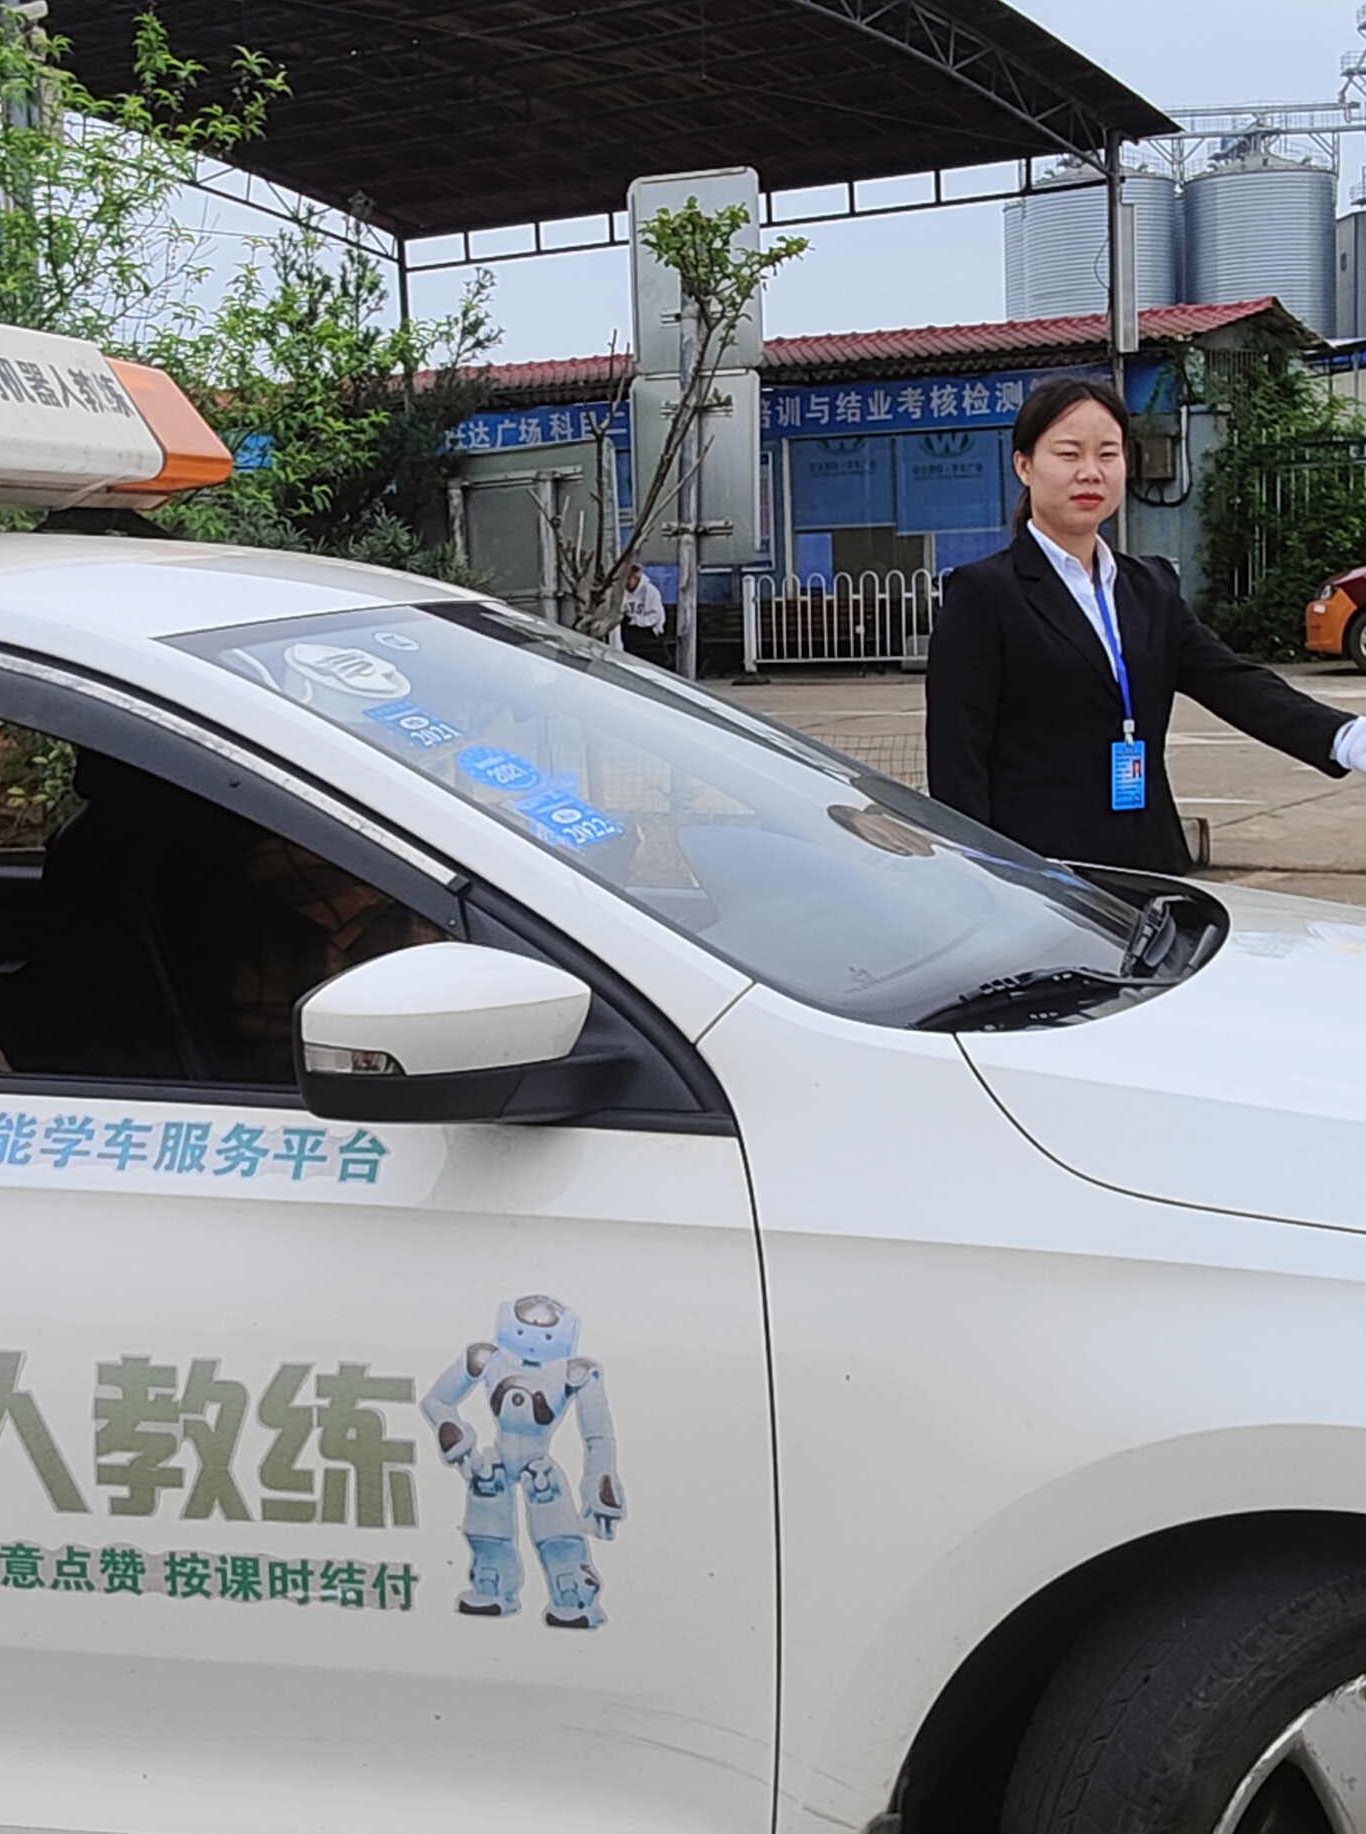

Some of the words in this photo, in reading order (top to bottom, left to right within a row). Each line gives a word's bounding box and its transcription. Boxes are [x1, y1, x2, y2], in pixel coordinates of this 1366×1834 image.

[760, 377, 1040, 429] 训与结业考核检测
[411, 722, 464, 747] 2021
[562, 817, 615, 844] 2022
[163, 1552, 420, 1612] 按课时结付
